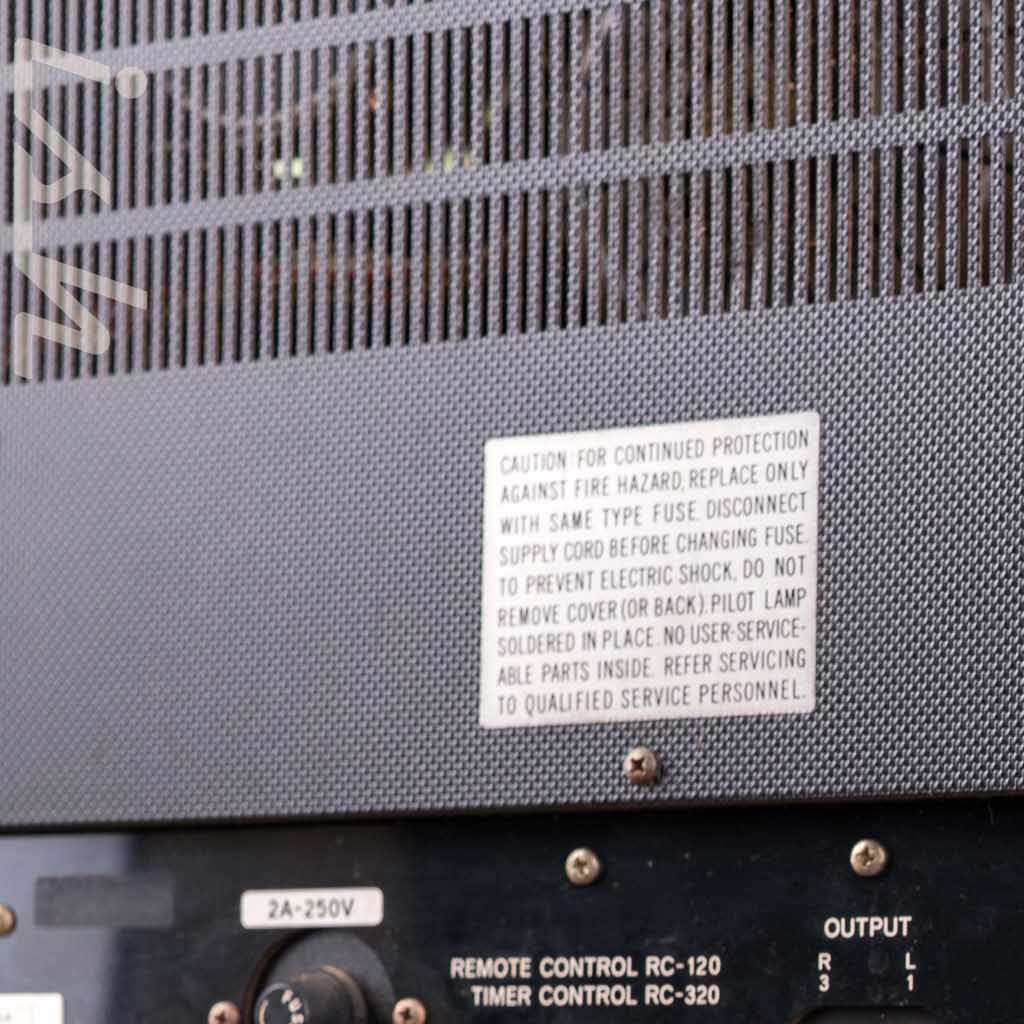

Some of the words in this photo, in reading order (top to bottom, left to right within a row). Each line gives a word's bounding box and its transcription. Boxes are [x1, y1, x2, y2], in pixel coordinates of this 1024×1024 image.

[577, 448, 607, 469] FOR
[614, 438, 704, 466] CONTINUED
[713, 429, 808, 456] PROTECTION
[500, 479, 567, 503] AGAINST
[575, 475, 609, 497] FIRE
[689, 464, 759, 488] REPLACE
[766, 460, 808, 483] ONLY
[500, 513, 540, 534] WITH
[550, 509, 593, 533] SAME
[602, 505, 642, 528] TYPE
[706, 492, 807, 519] DISCONNECT
[499, 543, 558, 566] SUPPLY
[564, 538, 604, 561] CORD
[609, 533, 670, 558] BEFORE
[676, 528, 758, 553] CHANGING
[500, 576, 518, 596] TO
[526, 570, 594, 595] PREVENT
[601, 565, 673, 590] ELECTRIC
[743, 558, 765, 579] DO
[775, 555, 806, 577] NOT
[498, 604, 560, 627] REMOVE
[711, 591, 755, 614] PILOT
[765, 587, 807, 610] LAMP
[498, 631, 576, 657] SOLDERED
[582, 631, 598, 650] IN
[664, 624, 685, 645] NO
[498, 665, 532, 686] ABLE
[542, 661, 590, 683] PARTS
[664, 653, 712, 676] REFER
[720, 648, 806, 673] SERVICING
[499, 696, 517, 716] TO
[525, 689, 613, 716] QUALIFIED
[621, 684, 691, 709] SERVICE
[699, 680, 807, 704] PERSONNEL.
[268, 898, 355, 919] 2A-250V
[823, 916, 912, 939] OUTPUT
[450, 957, 532, 979] REMOTE
[538, 956, 640, 978] CONTROL
[645, 955, 722, 977] RC-120
[817, 952, 832, 970] R
[905, 953, 916, 970] L
[470, 985, 532, 1007] TIMER
[538, 984, 638, 1006] CONTROL
[644, 983, 721, 1006] RC-320
[819, 974, 831, 992] 3
[906, 974, 914, 991] 1
